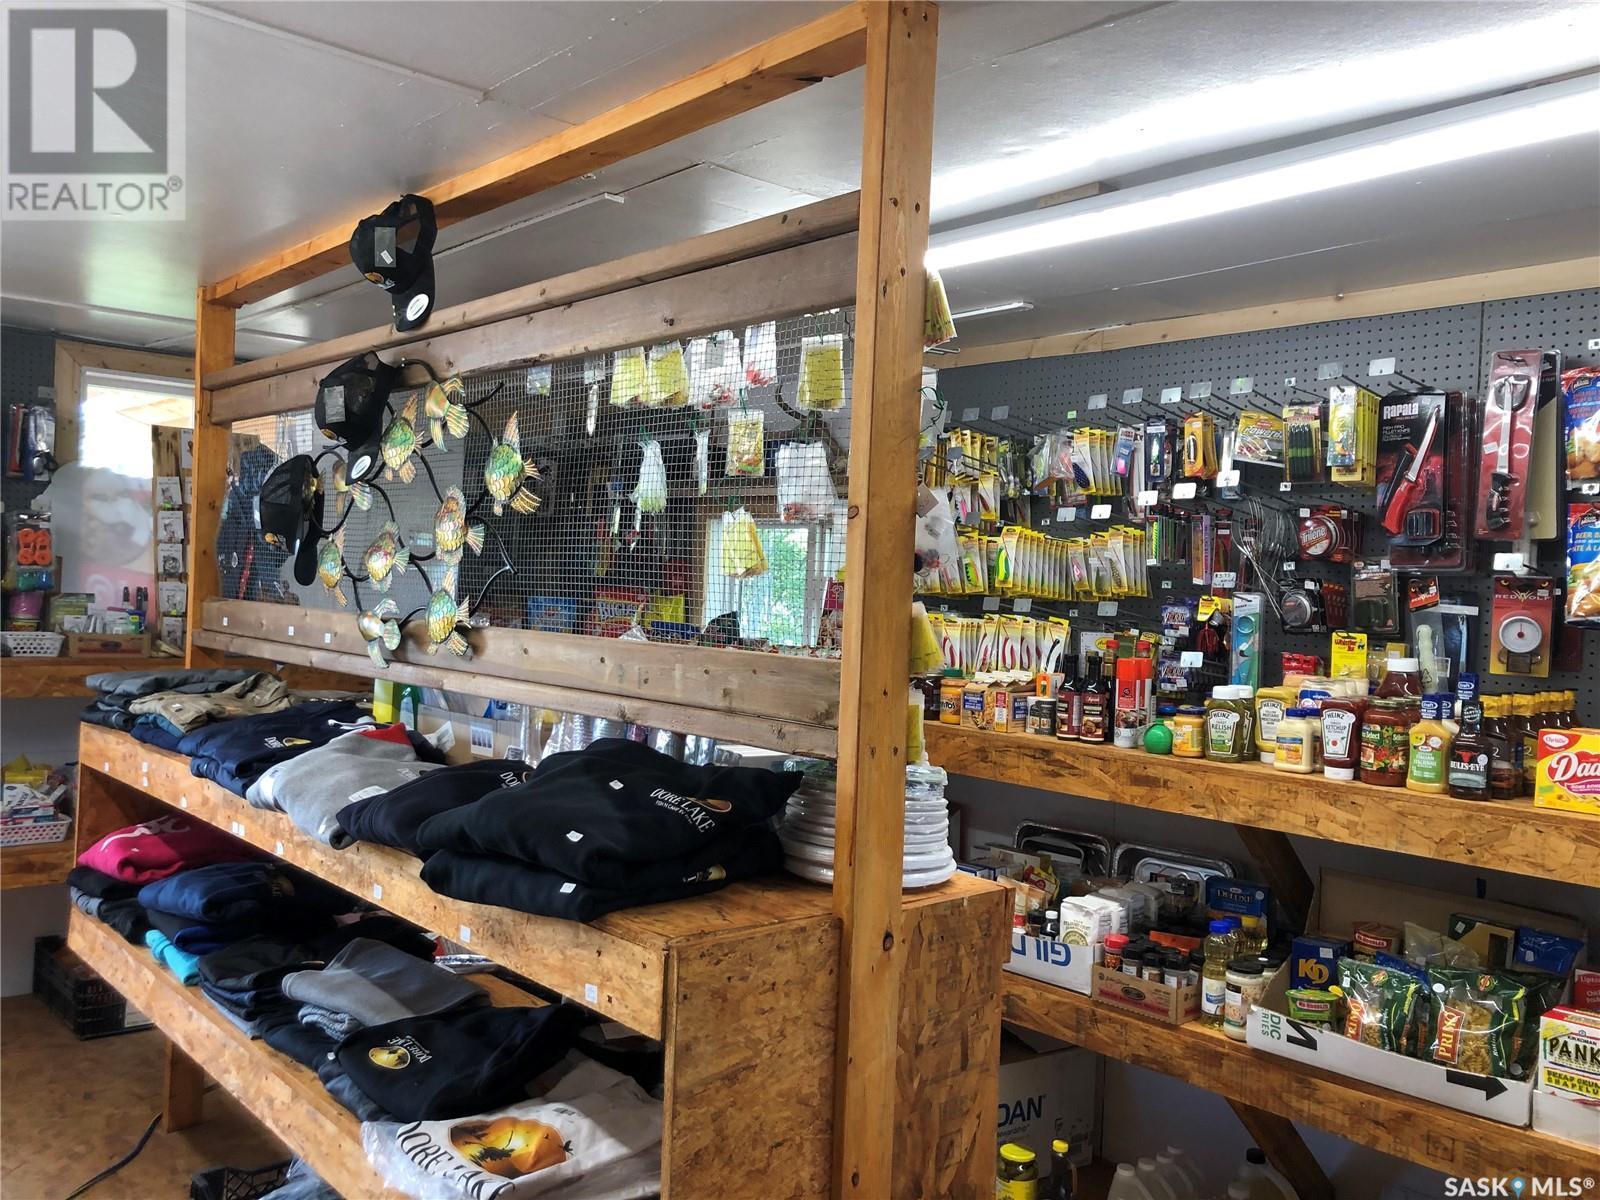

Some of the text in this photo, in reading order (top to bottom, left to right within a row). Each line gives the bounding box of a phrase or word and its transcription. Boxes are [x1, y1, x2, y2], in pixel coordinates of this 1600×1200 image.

[1301, 527, 1327, 543] Trilene
[1213, 712, 1231, 720] HEINZ
[1327, 712, 1345, 720] HEINZ
[1211, 723, 1232, 731] RELISH
[680, 801, 716, 833] LAKE
[1298, 958, 1329, 984] KD
[1438, 1011, 1461, 1058] PRIMO
